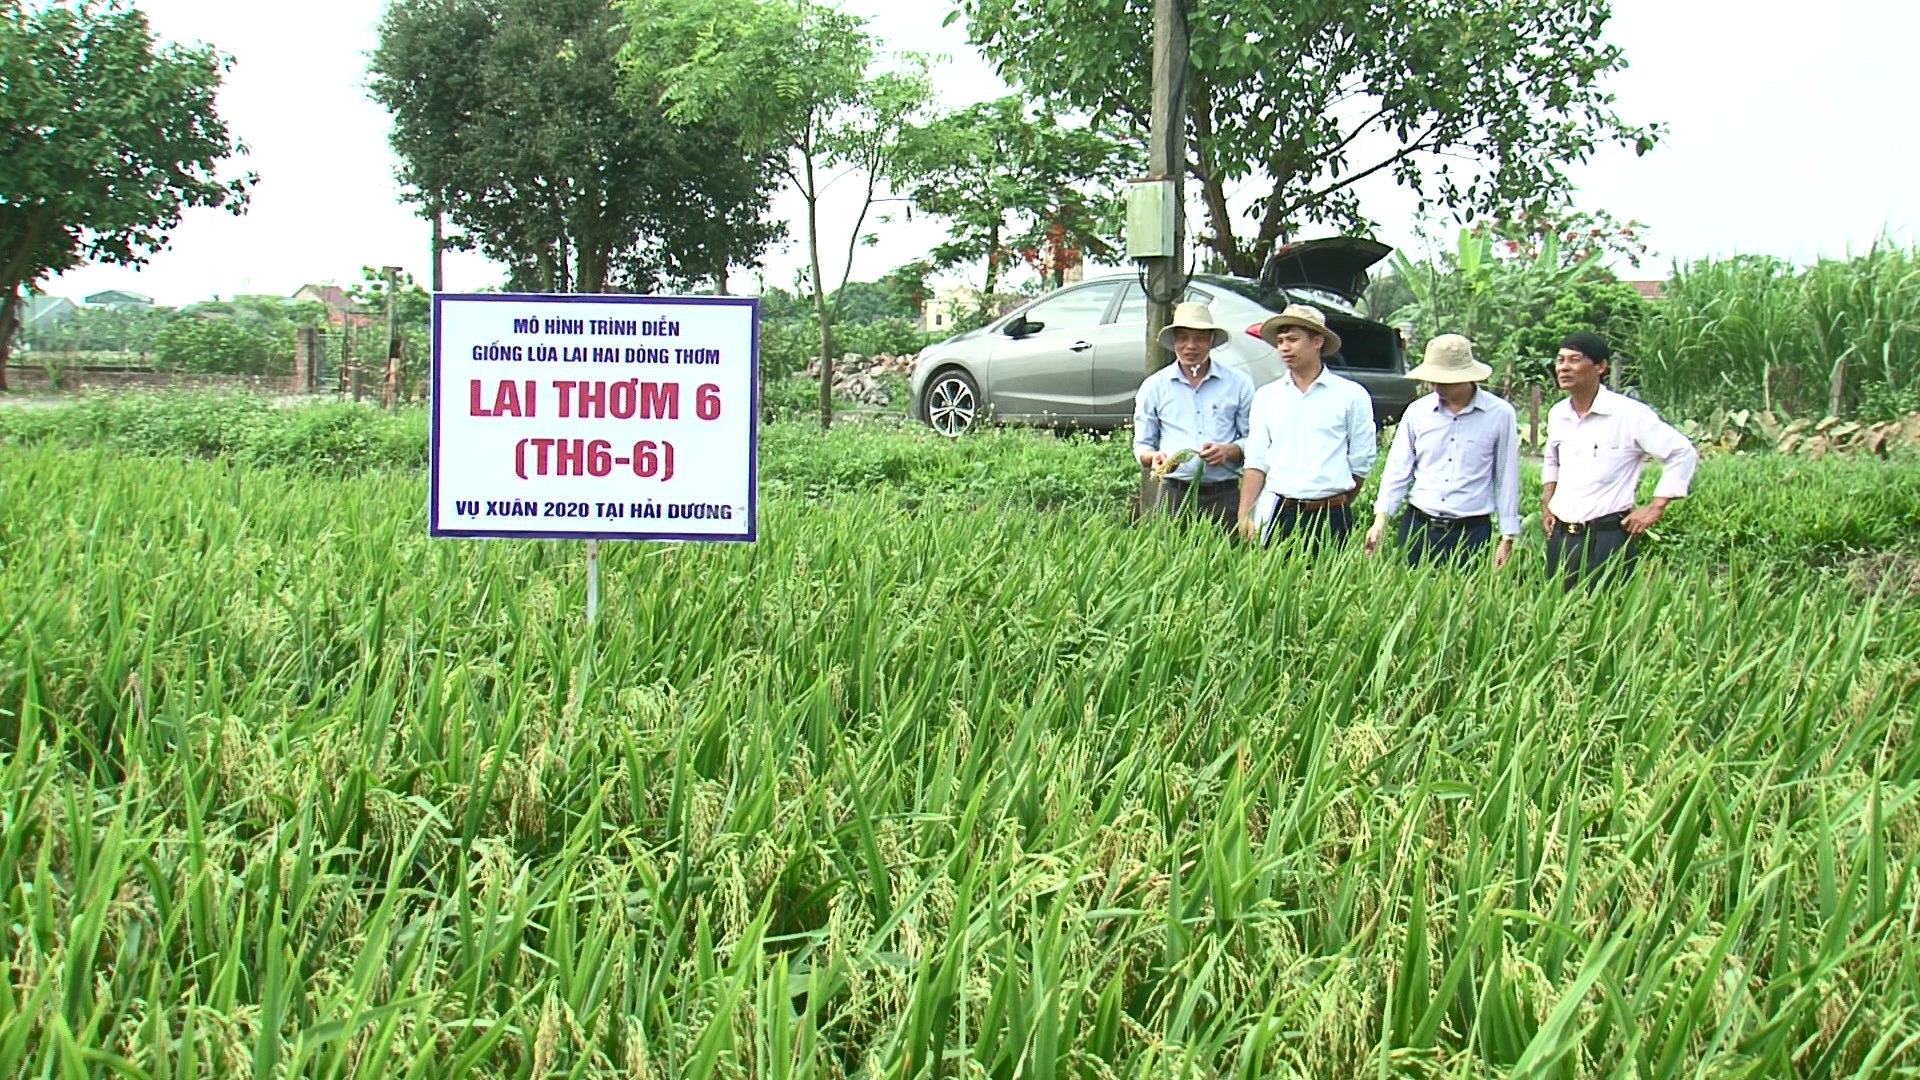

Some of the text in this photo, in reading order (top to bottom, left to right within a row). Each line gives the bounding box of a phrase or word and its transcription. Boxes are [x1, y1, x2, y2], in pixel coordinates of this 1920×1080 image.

[514, 315, 679, 336] MÔ HÌNH TRÌNH DIỄN
[472, 340, 522, 361] GIỐNG
[563, 347, 587, 362] LAI
[593, 347, 619, 363] HAI
[674, 348, 719, 364] THƠM
[470, 378, 721, 421] LAI THƠM 6
[515, 438, 674, 482] (TH6-6)
[456, 501, 479, 519] VỤ
[486, 498, 538, 516] XUÂN
[544, 502, 589, 517] 2020
[595, 503, 624, 521] TẠI
[668, 503, 732, 519] DƯƠNG
